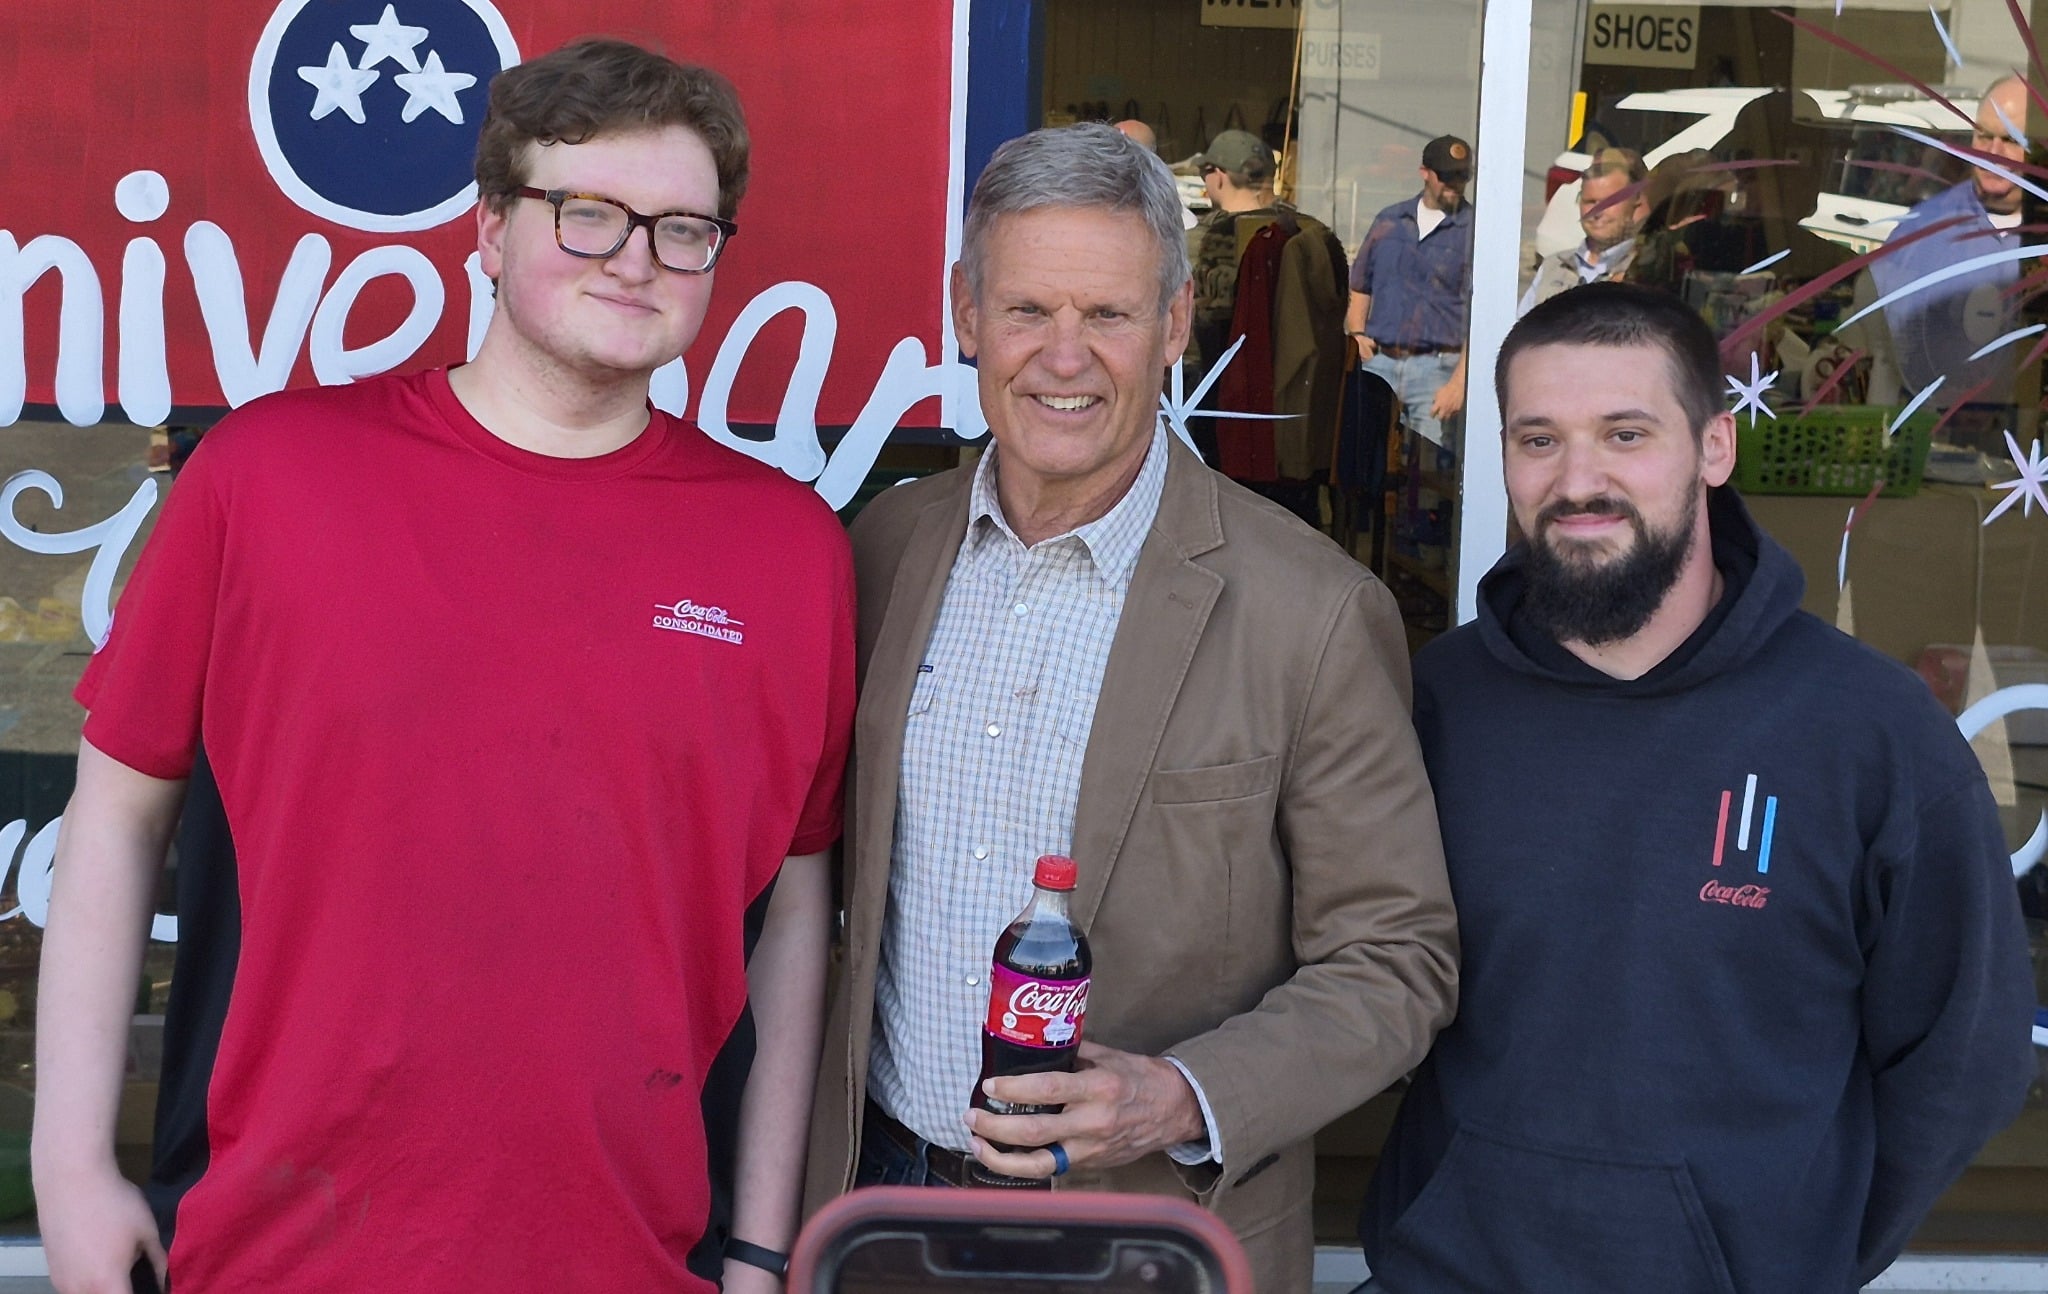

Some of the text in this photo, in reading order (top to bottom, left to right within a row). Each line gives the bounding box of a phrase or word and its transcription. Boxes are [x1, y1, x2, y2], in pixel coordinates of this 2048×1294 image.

[1593, 13, 1692, 53] SHOES
[1303, 41, 1376, 69] PURSES
[653, 615, 743, 642] CONSOLIDATED
